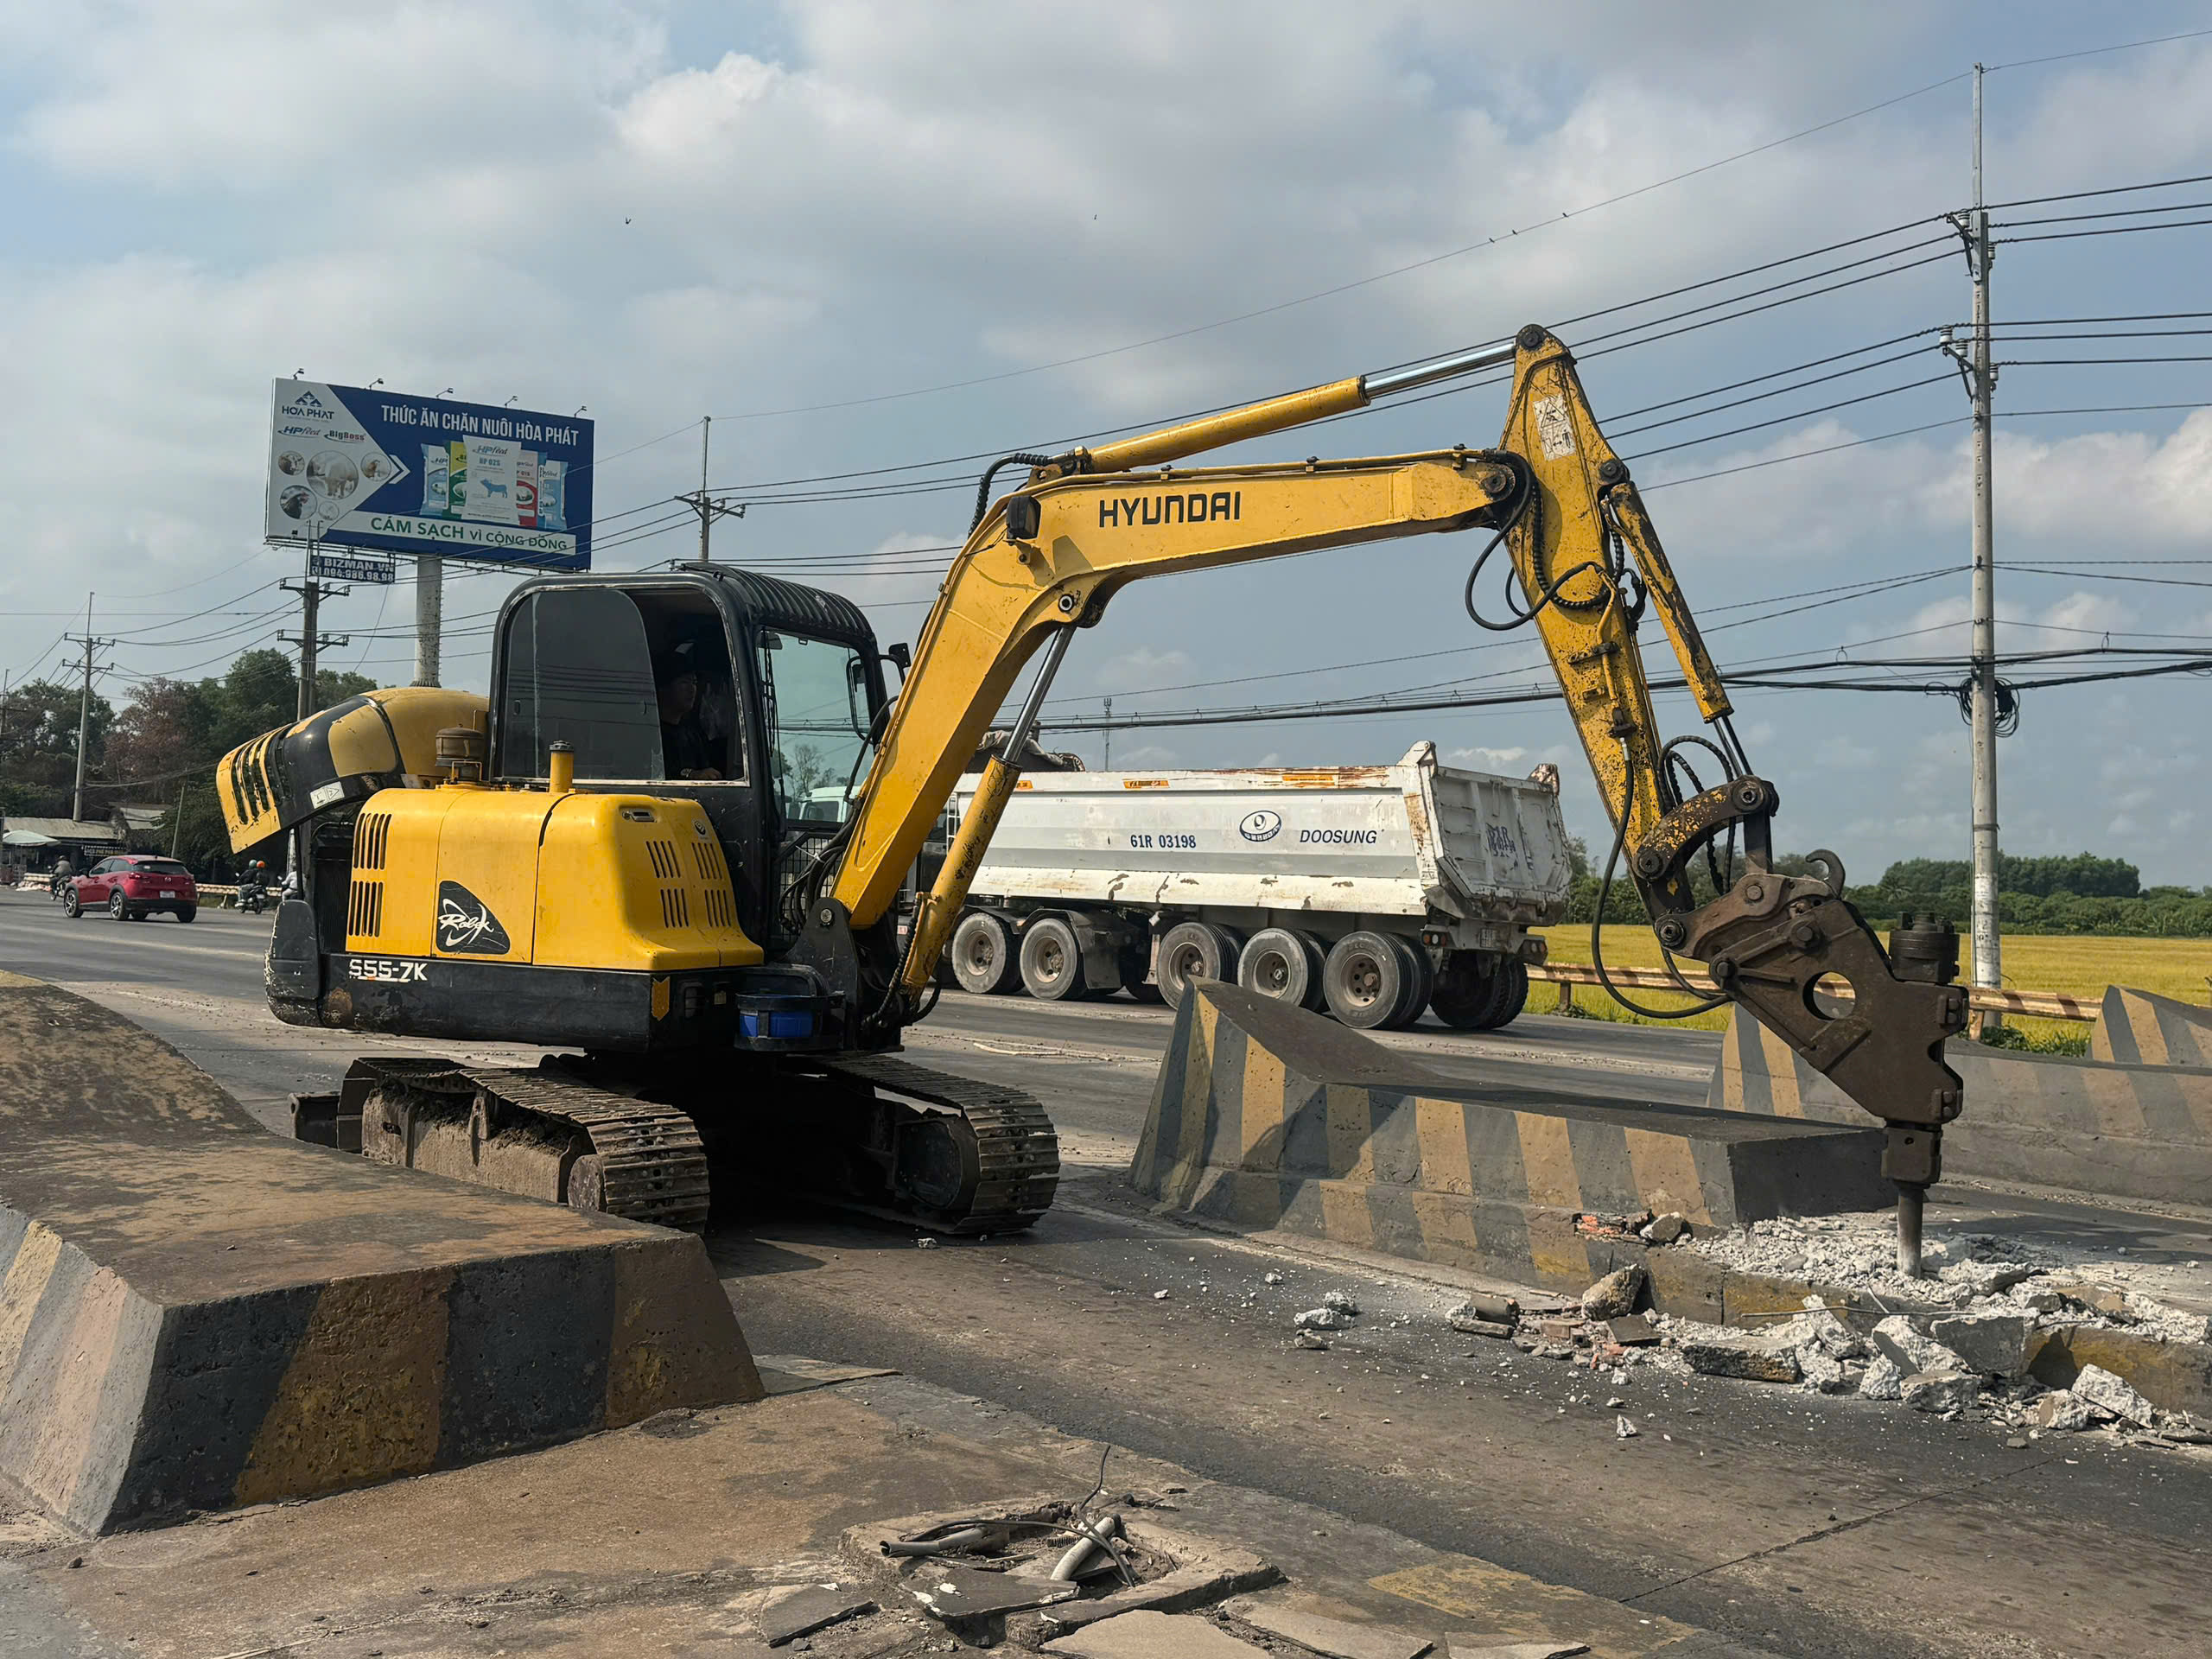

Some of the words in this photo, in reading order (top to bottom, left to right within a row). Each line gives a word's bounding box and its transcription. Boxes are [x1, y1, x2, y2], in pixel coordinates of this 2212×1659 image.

[381, 404, 417, 425] THỨC
[420, 410, 439, 429] ĂN
[442, 412, 479, 433] CHĂN
[482, 419, 512, 438] NUÔI
[516, 421, 543, 442] HÒA
[545, 425, 579, 447] PHÁT
[1099, 491, 1241, 528] HYUNDAI
[371, 516, 411, 534] CÁM
[417, 522, 464, 540] SẠCH
[469, 529, 482, 541] VÌ
[486, 531, 524, 546] CỘNG
[1130, 835, 1153, 849] 61R
[1159, 834, 1197, 849] 03198
[1300, 830, 1377, 844] DOOSUNG
